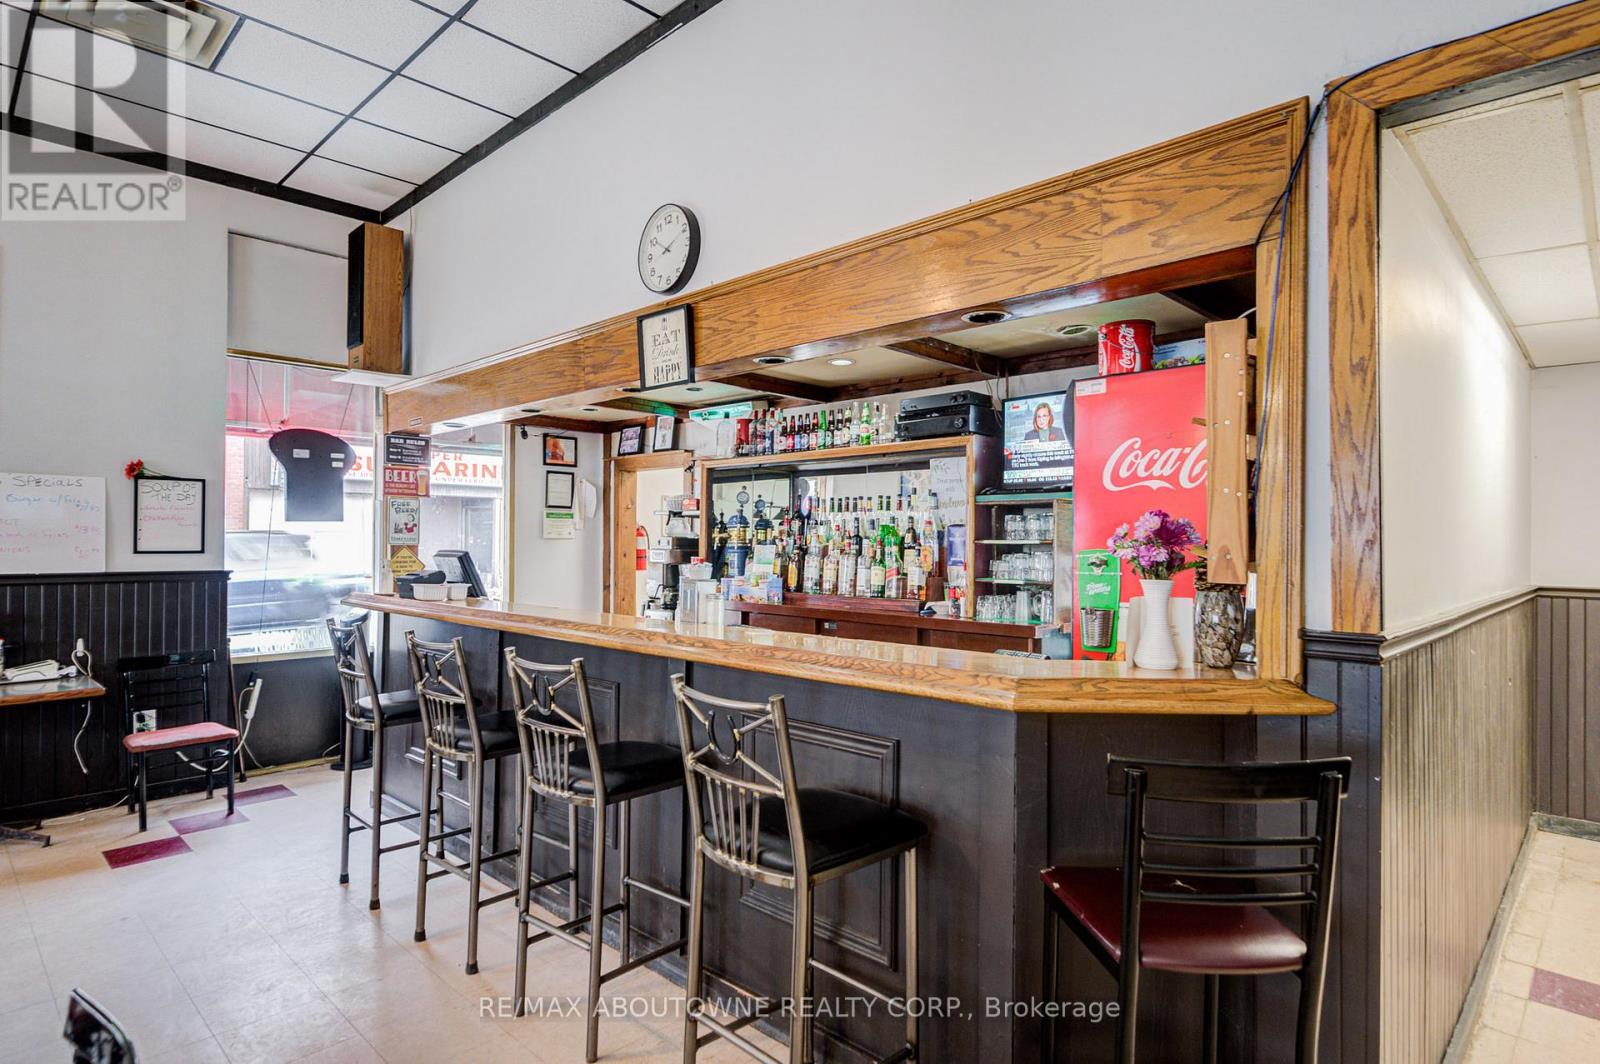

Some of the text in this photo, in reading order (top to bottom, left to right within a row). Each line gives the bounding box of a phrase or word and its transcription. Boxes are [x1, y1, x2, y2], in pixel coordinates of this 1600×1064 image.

[651, 328, 681, 348] EAT
[431, 460, 503, 479] ARIN
[1102, 436, 1208, 492] Coca-C
[385, 469, 417, 483] BEER
